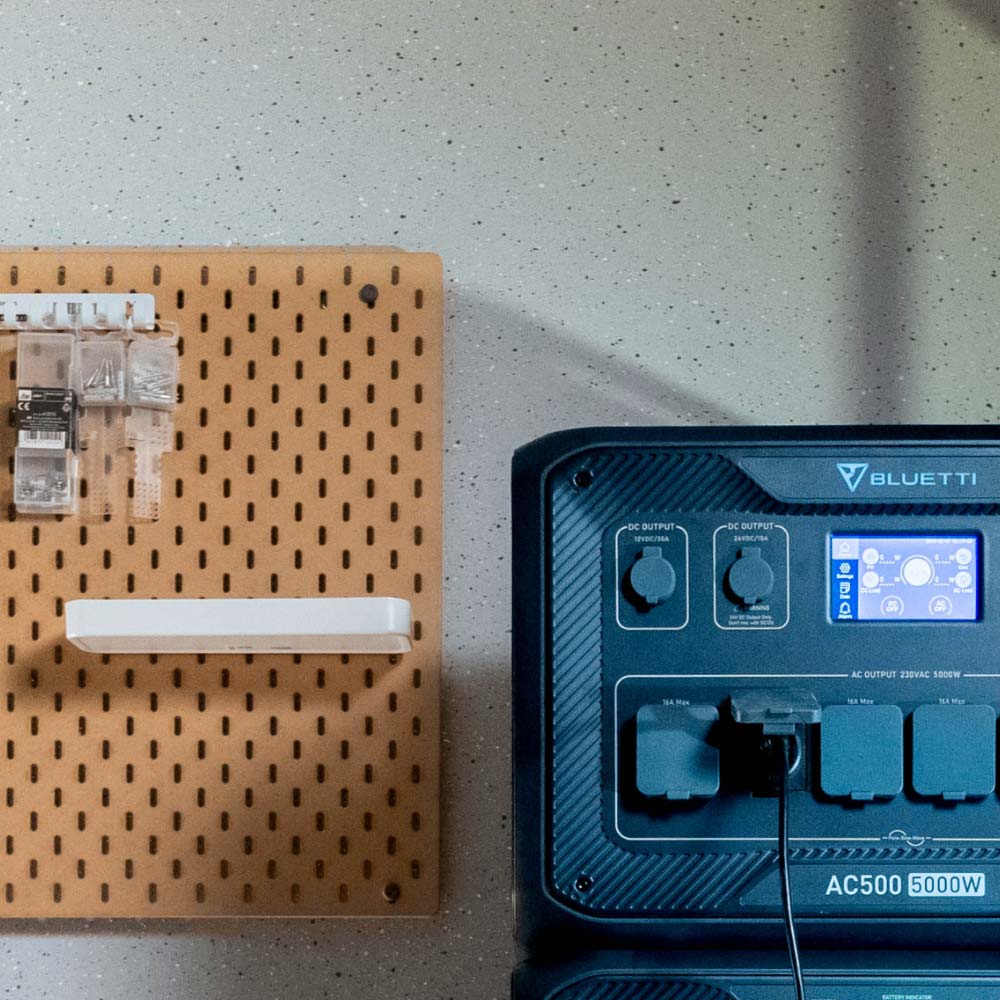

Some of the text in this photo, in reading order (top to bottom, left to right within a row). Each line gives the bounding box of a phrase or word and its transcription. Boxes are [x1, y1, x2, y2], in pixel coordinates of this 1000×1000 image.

[870, 472, 977, 486] BLUETTI
[627, 522, 676, 531] DC OUTPUT
[727, 522, 775, 530] DC OUTPUT
[851, 671, 961, 679] AC OUTPUT 230VAC 5000W
[825, 874, 982, 896] AC500 5000W
